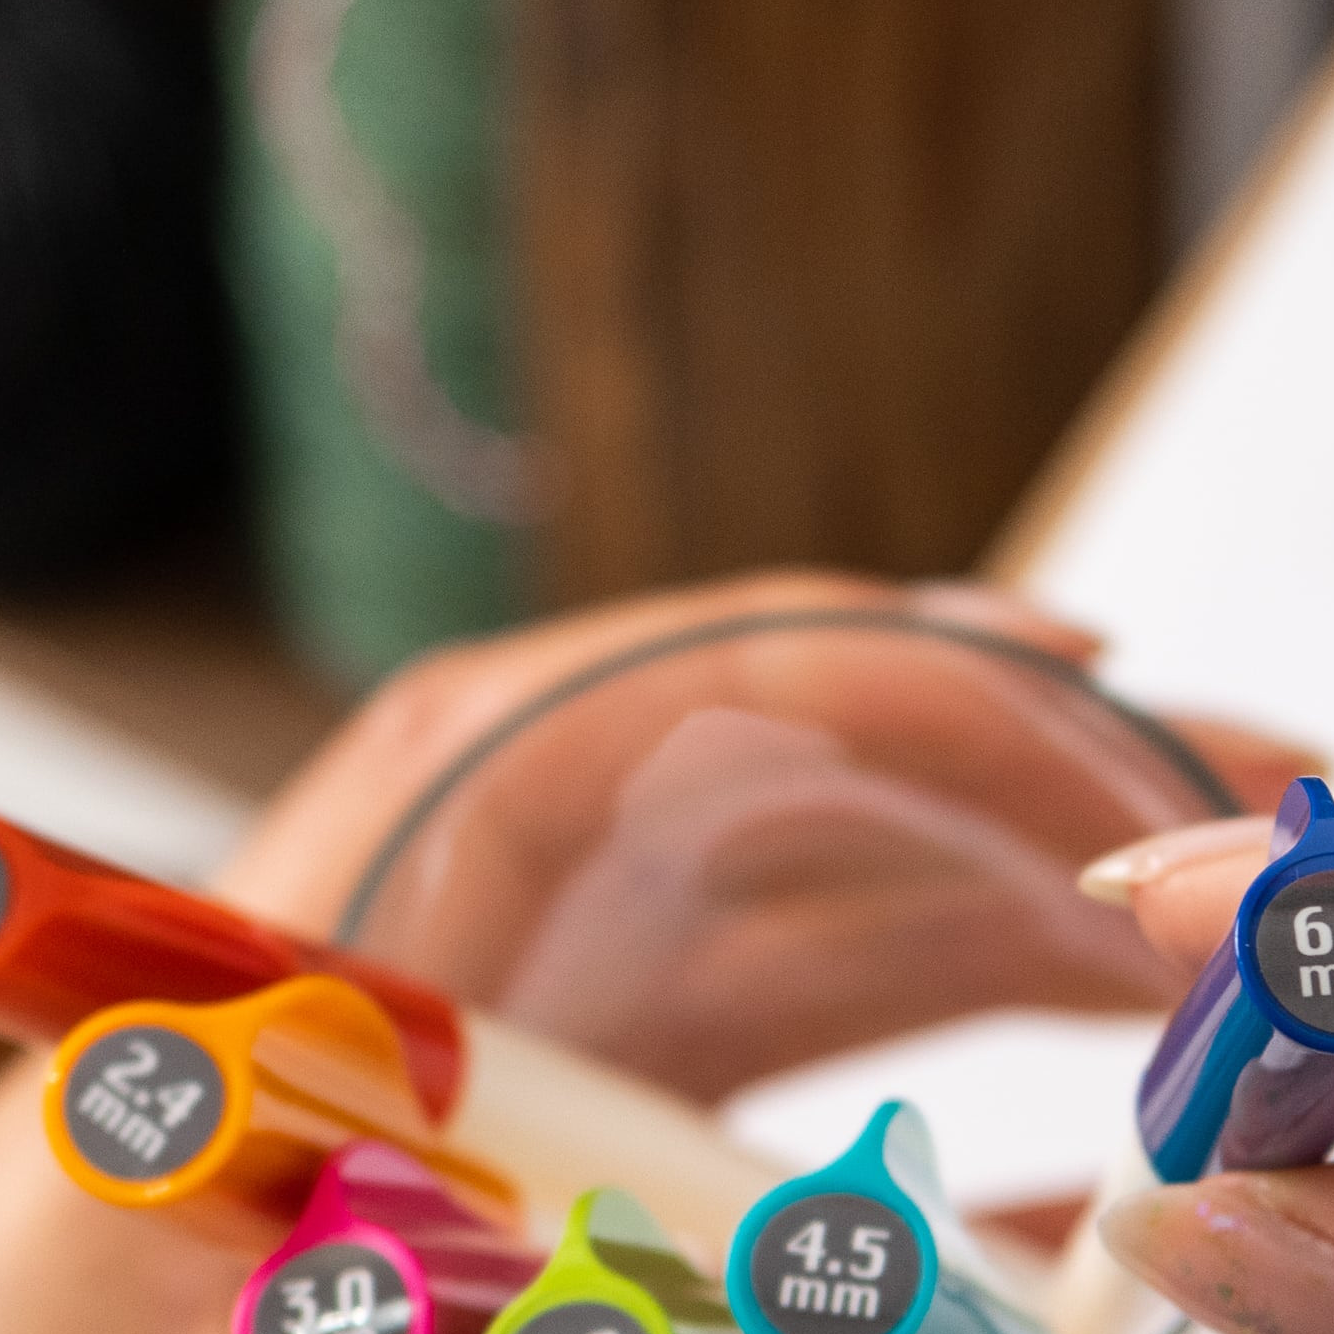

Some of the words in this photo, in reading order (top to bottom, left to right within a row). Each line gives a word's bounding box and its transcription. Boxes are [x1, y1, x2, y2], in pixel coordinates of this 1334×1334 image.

[103, 1038, 204, 1128] 2.4
[78, 1083, 167, 1162] mm
[785, 1220, 891, 1281] 4.5
[778, 1274, 879, 1321] mm
